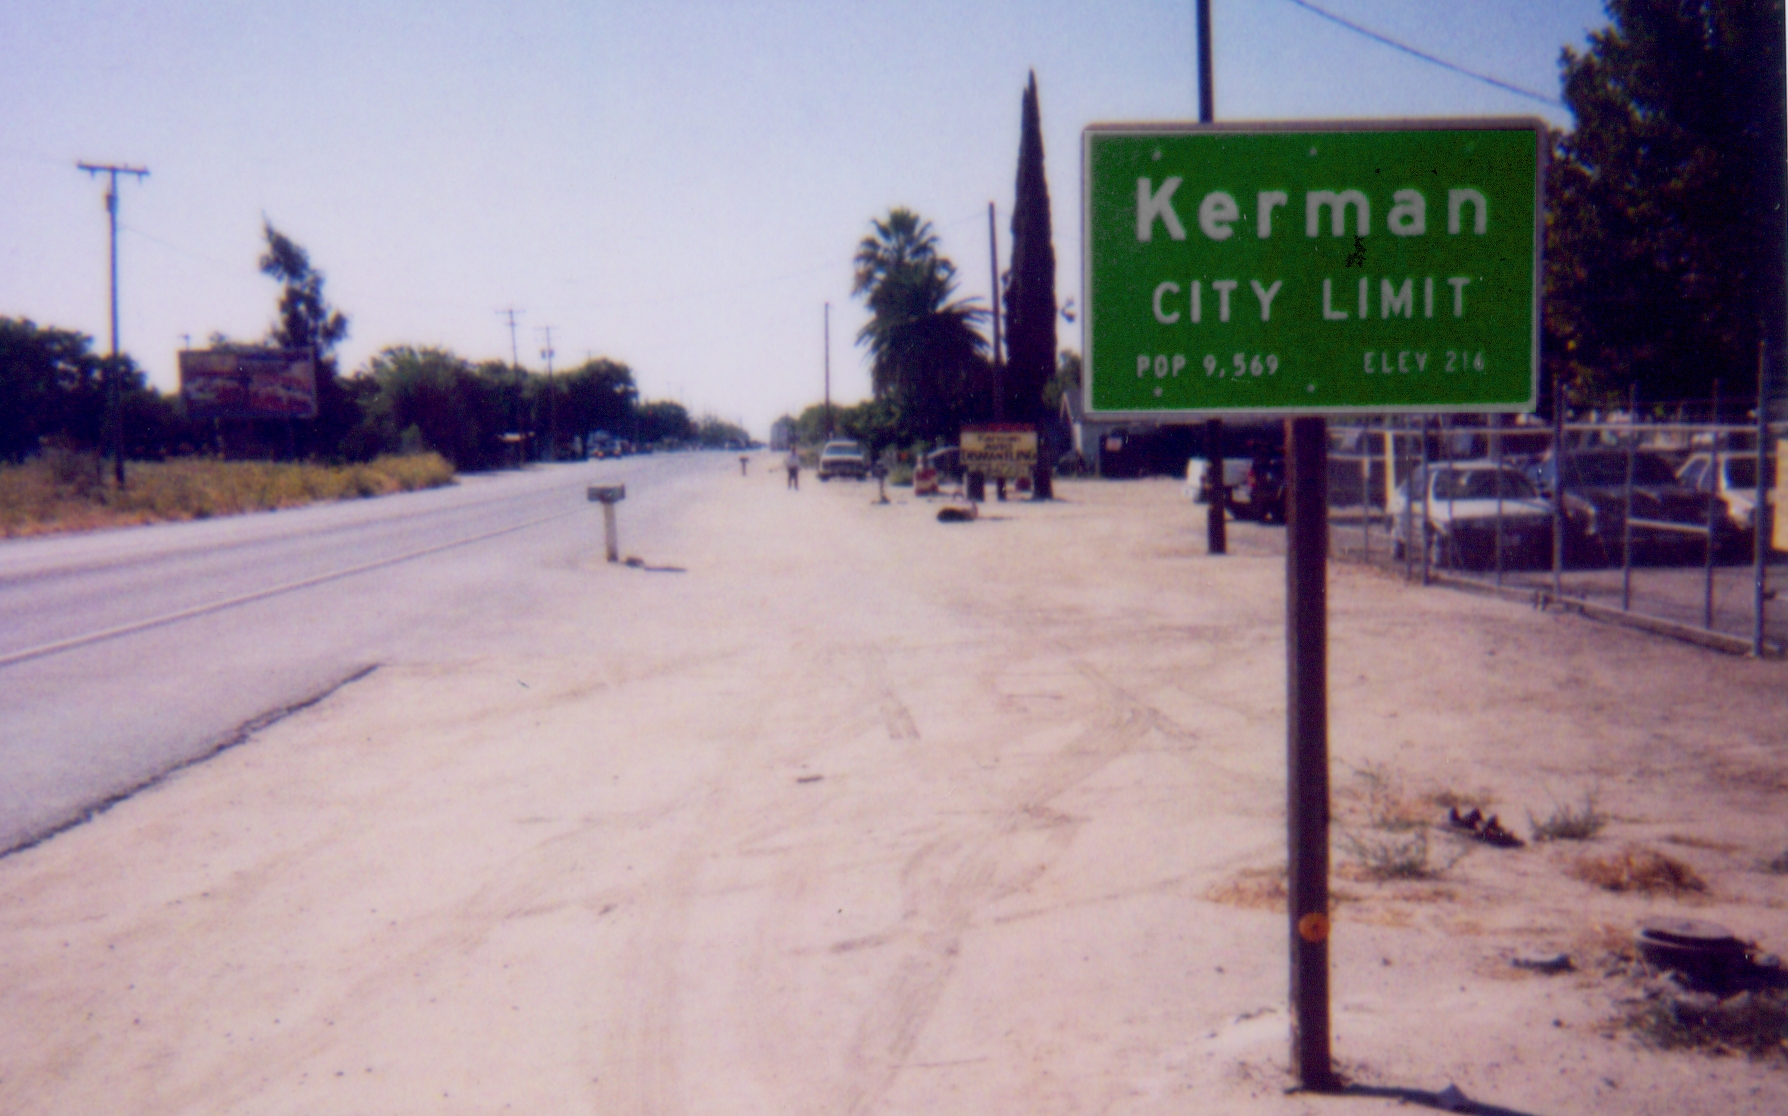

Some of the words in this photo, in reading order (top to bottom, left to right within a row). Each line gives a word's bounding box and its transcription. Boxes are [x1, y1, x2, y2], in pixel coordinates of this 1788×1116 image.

[1136, 176, 1487, 242] Kerman
[1152, 280, 1283, 323] CITY
[1322, 277, 1471, 320] LIMIT
[1136, 354, 1186, 378] POP
[1203, 354, 1279, 377] 9,569
[1363, 351, 1428, 374] ELEV
[1444, 350, 1486, 373] 216
